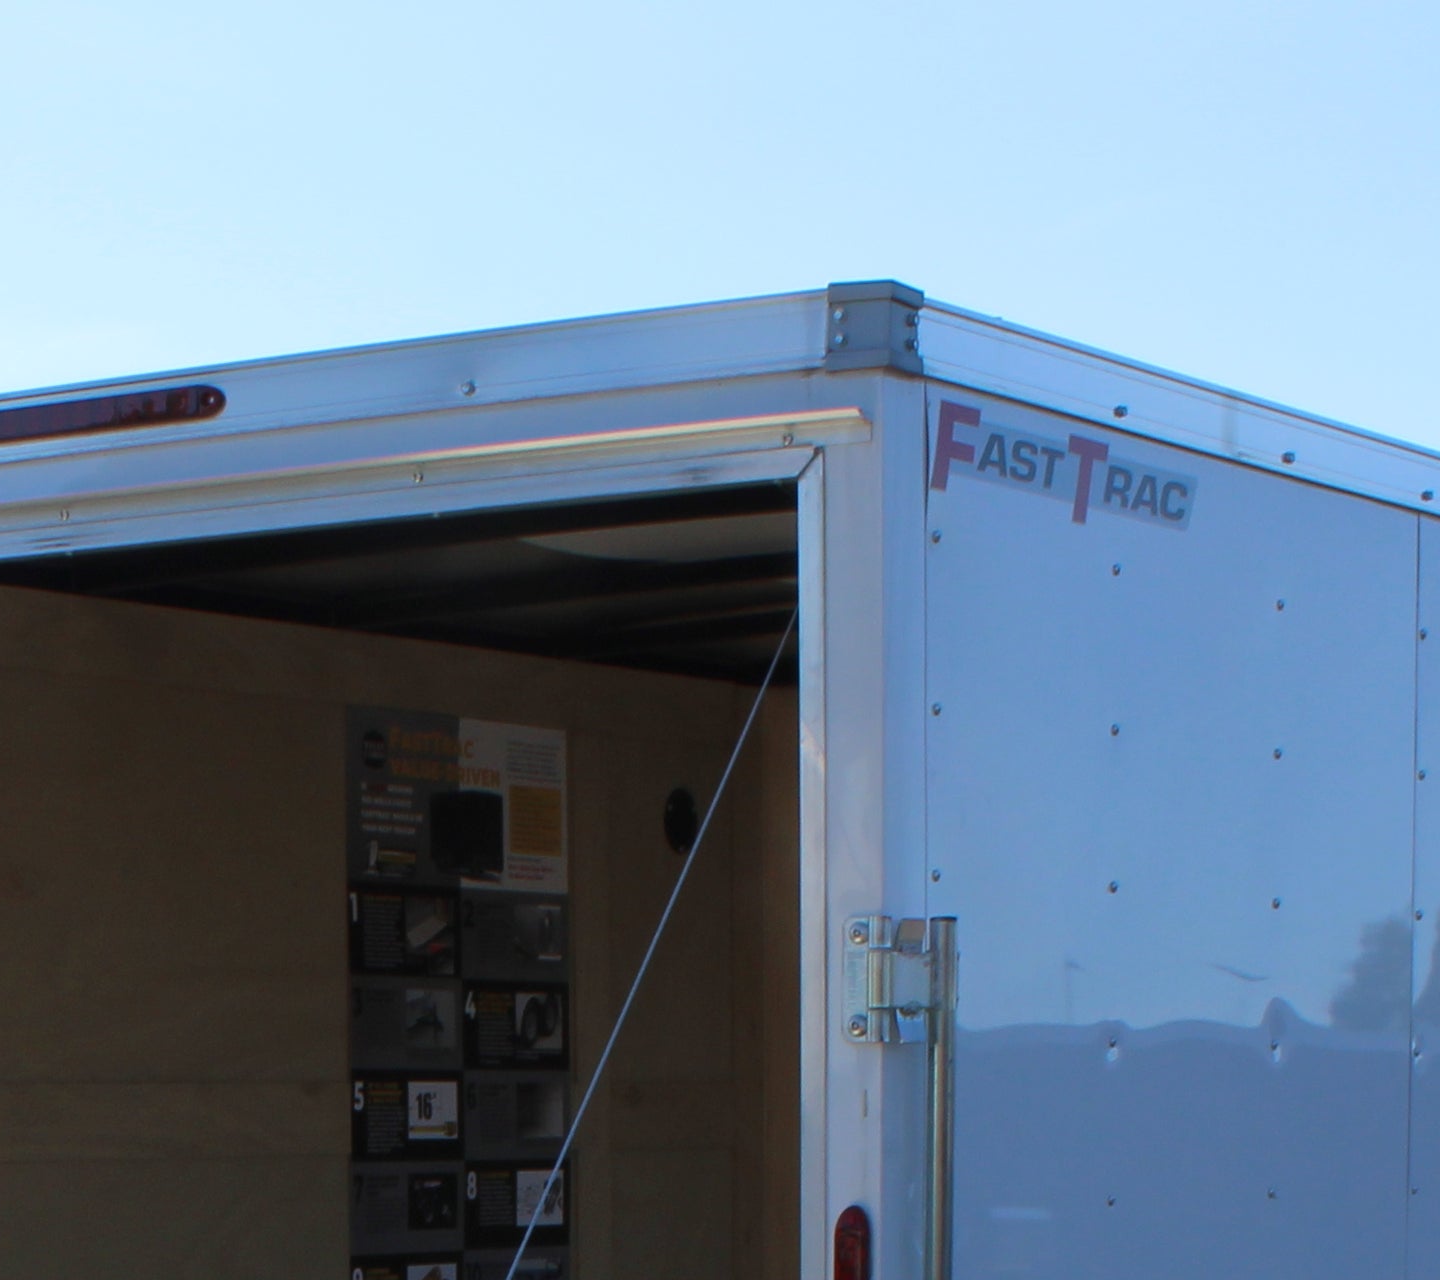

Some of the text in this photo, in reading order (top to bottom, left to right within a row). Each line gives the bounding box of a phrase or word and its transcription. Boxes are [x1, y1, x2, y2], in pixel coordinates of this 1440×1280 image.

[349, 891, 358, 923] 1
[465, 991, 476, 1019] 4
[353, 1081, 365, 1111] 5
[353, 1174, 364, 1206] 7
[467, 1171, 477, 1200] 8
